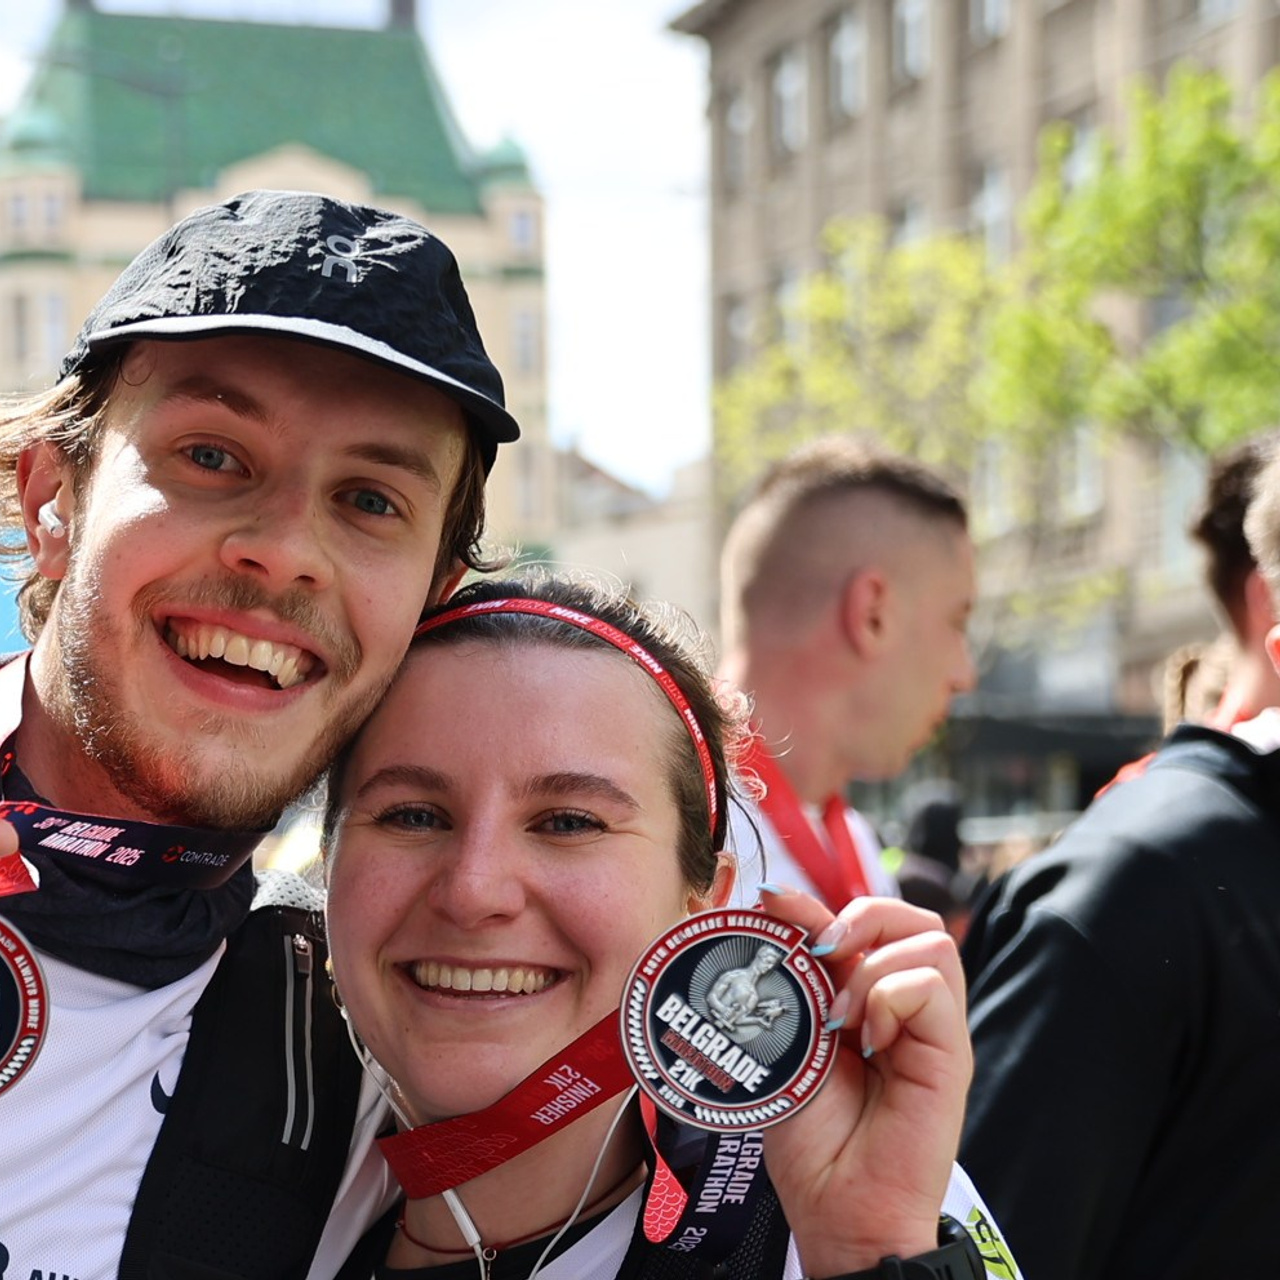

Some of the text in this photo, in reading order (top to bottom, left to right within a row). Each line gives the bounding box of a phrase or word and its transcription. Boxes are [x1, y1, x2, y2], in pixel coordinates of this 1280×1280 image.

[549, 606, 595, 626] NIKE
[628, 644, 664, 674] NIKE
[684, 708, 705, 743] NIKE
[37, 832, 146, 867] MARATHON 2025
[59, 821, 125, 843] BELGRADE
[179, 850, 232, 868] COMTRADE
[666, 916, 725, 950] BELGRADE
[726, 915, 795, 941] MARATHON
[14, 954, 40, 997] ALWAYS
[27, 998, 40, 1030] MORE
[655, 992, 770, 1094] BELGRADE
[542, 1064, 582, 1092] 21K
[667, 1058, 706, 1093] 21K
[791, 1068, 819, 1098] MORE
[529, 1077, 603, 1126] FINISHER
[657, 1085, 688, 1110] 2025
[695, 1134, 742, 1213] RATHON
[721, 1132, 764, 1205] LGRADE
